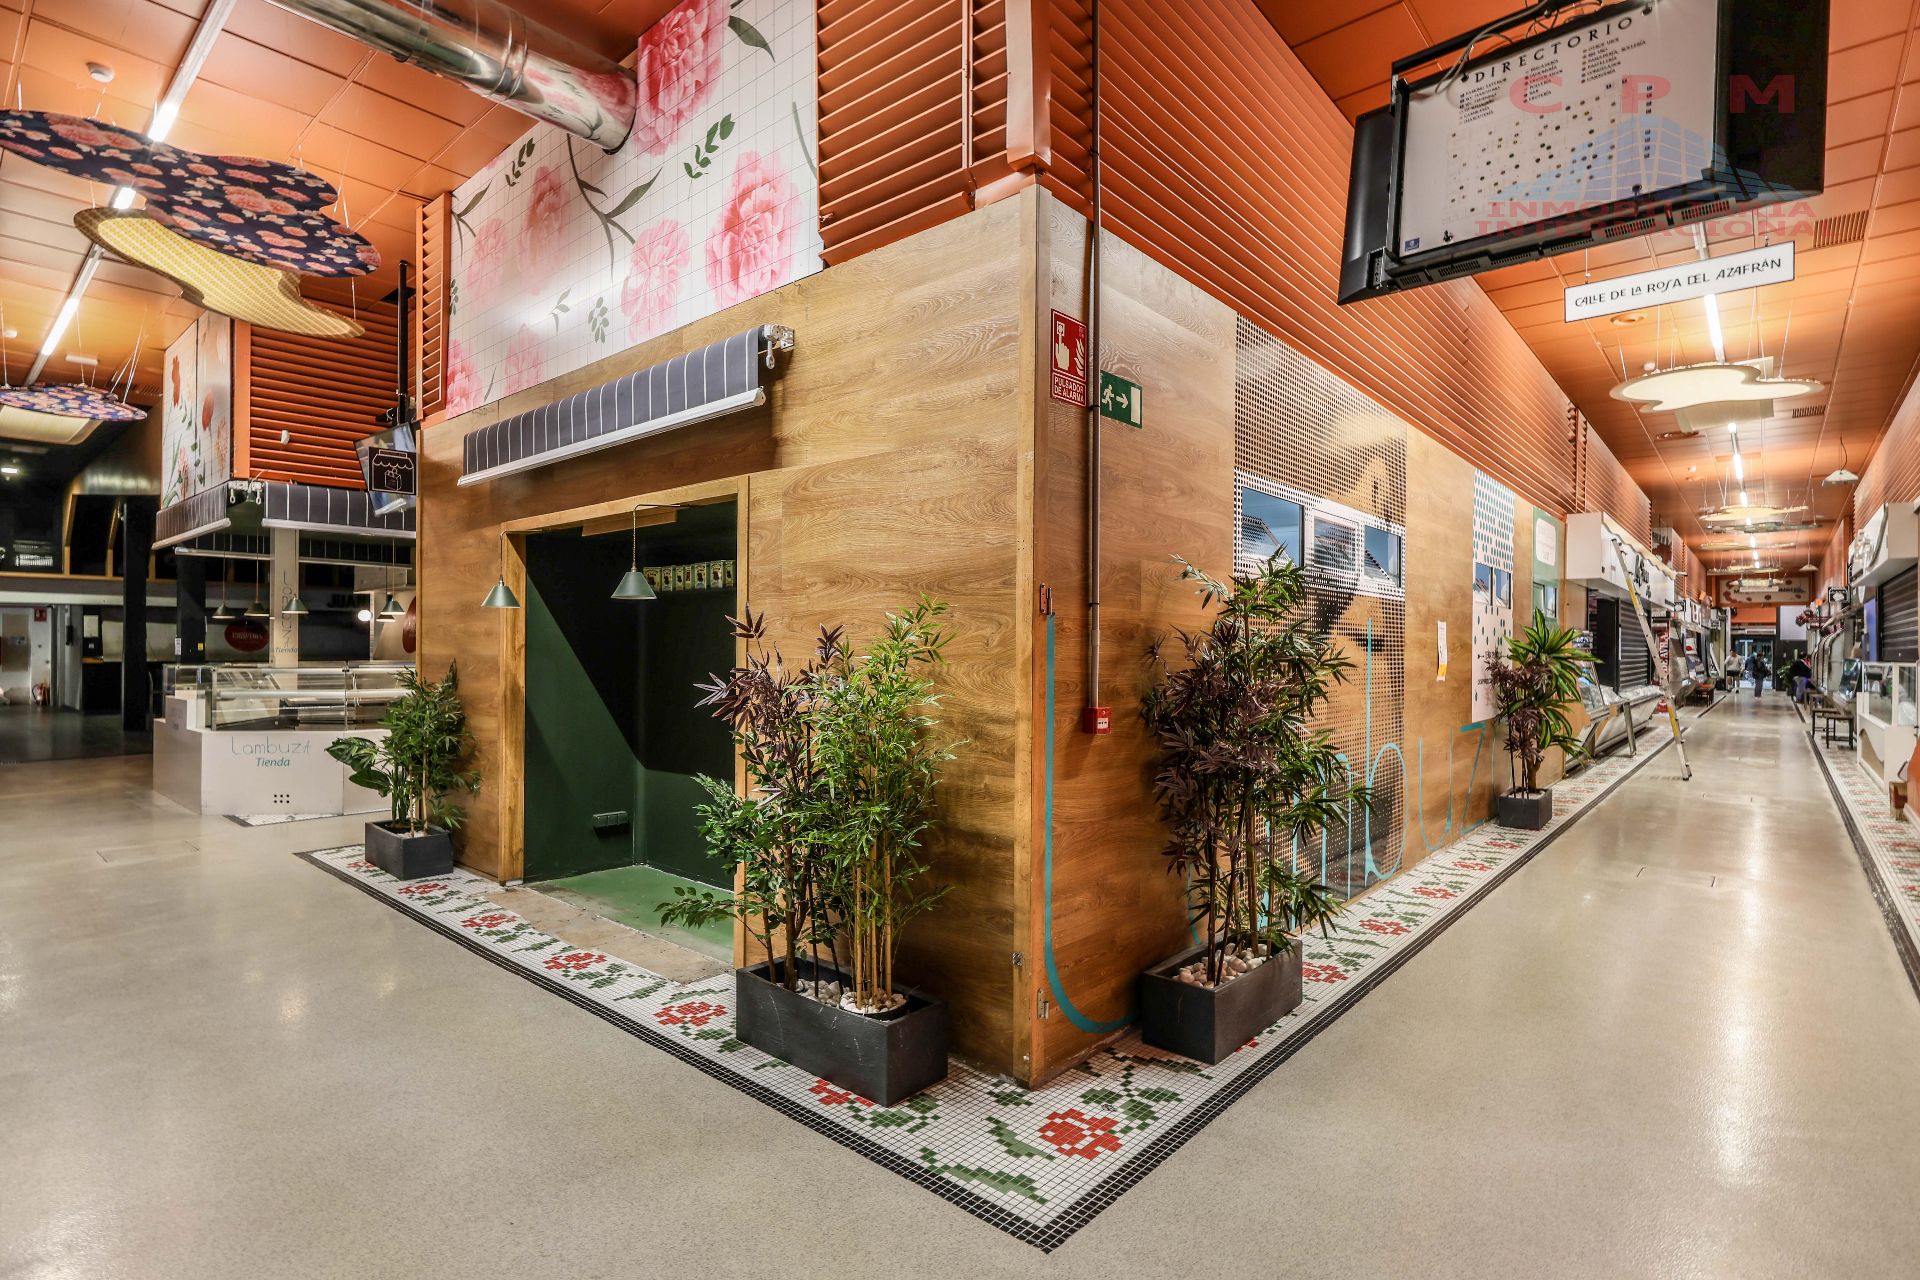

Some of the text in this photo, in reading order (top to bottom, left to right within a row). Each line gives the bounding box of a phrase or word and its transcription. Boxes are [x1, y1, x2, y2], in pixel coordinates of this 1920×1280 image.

[1474, 17, 1632, 83] DIRECTORIO
[1575, 258, 1782, 307] CALLE DE LA ROSA DEL AZAFRÁN
[1054, 376, 1084, 394] PULSADOR
[1054, 386, 1084, 403] DE ALARMA
[256, 757, 290, 767] Tienda
